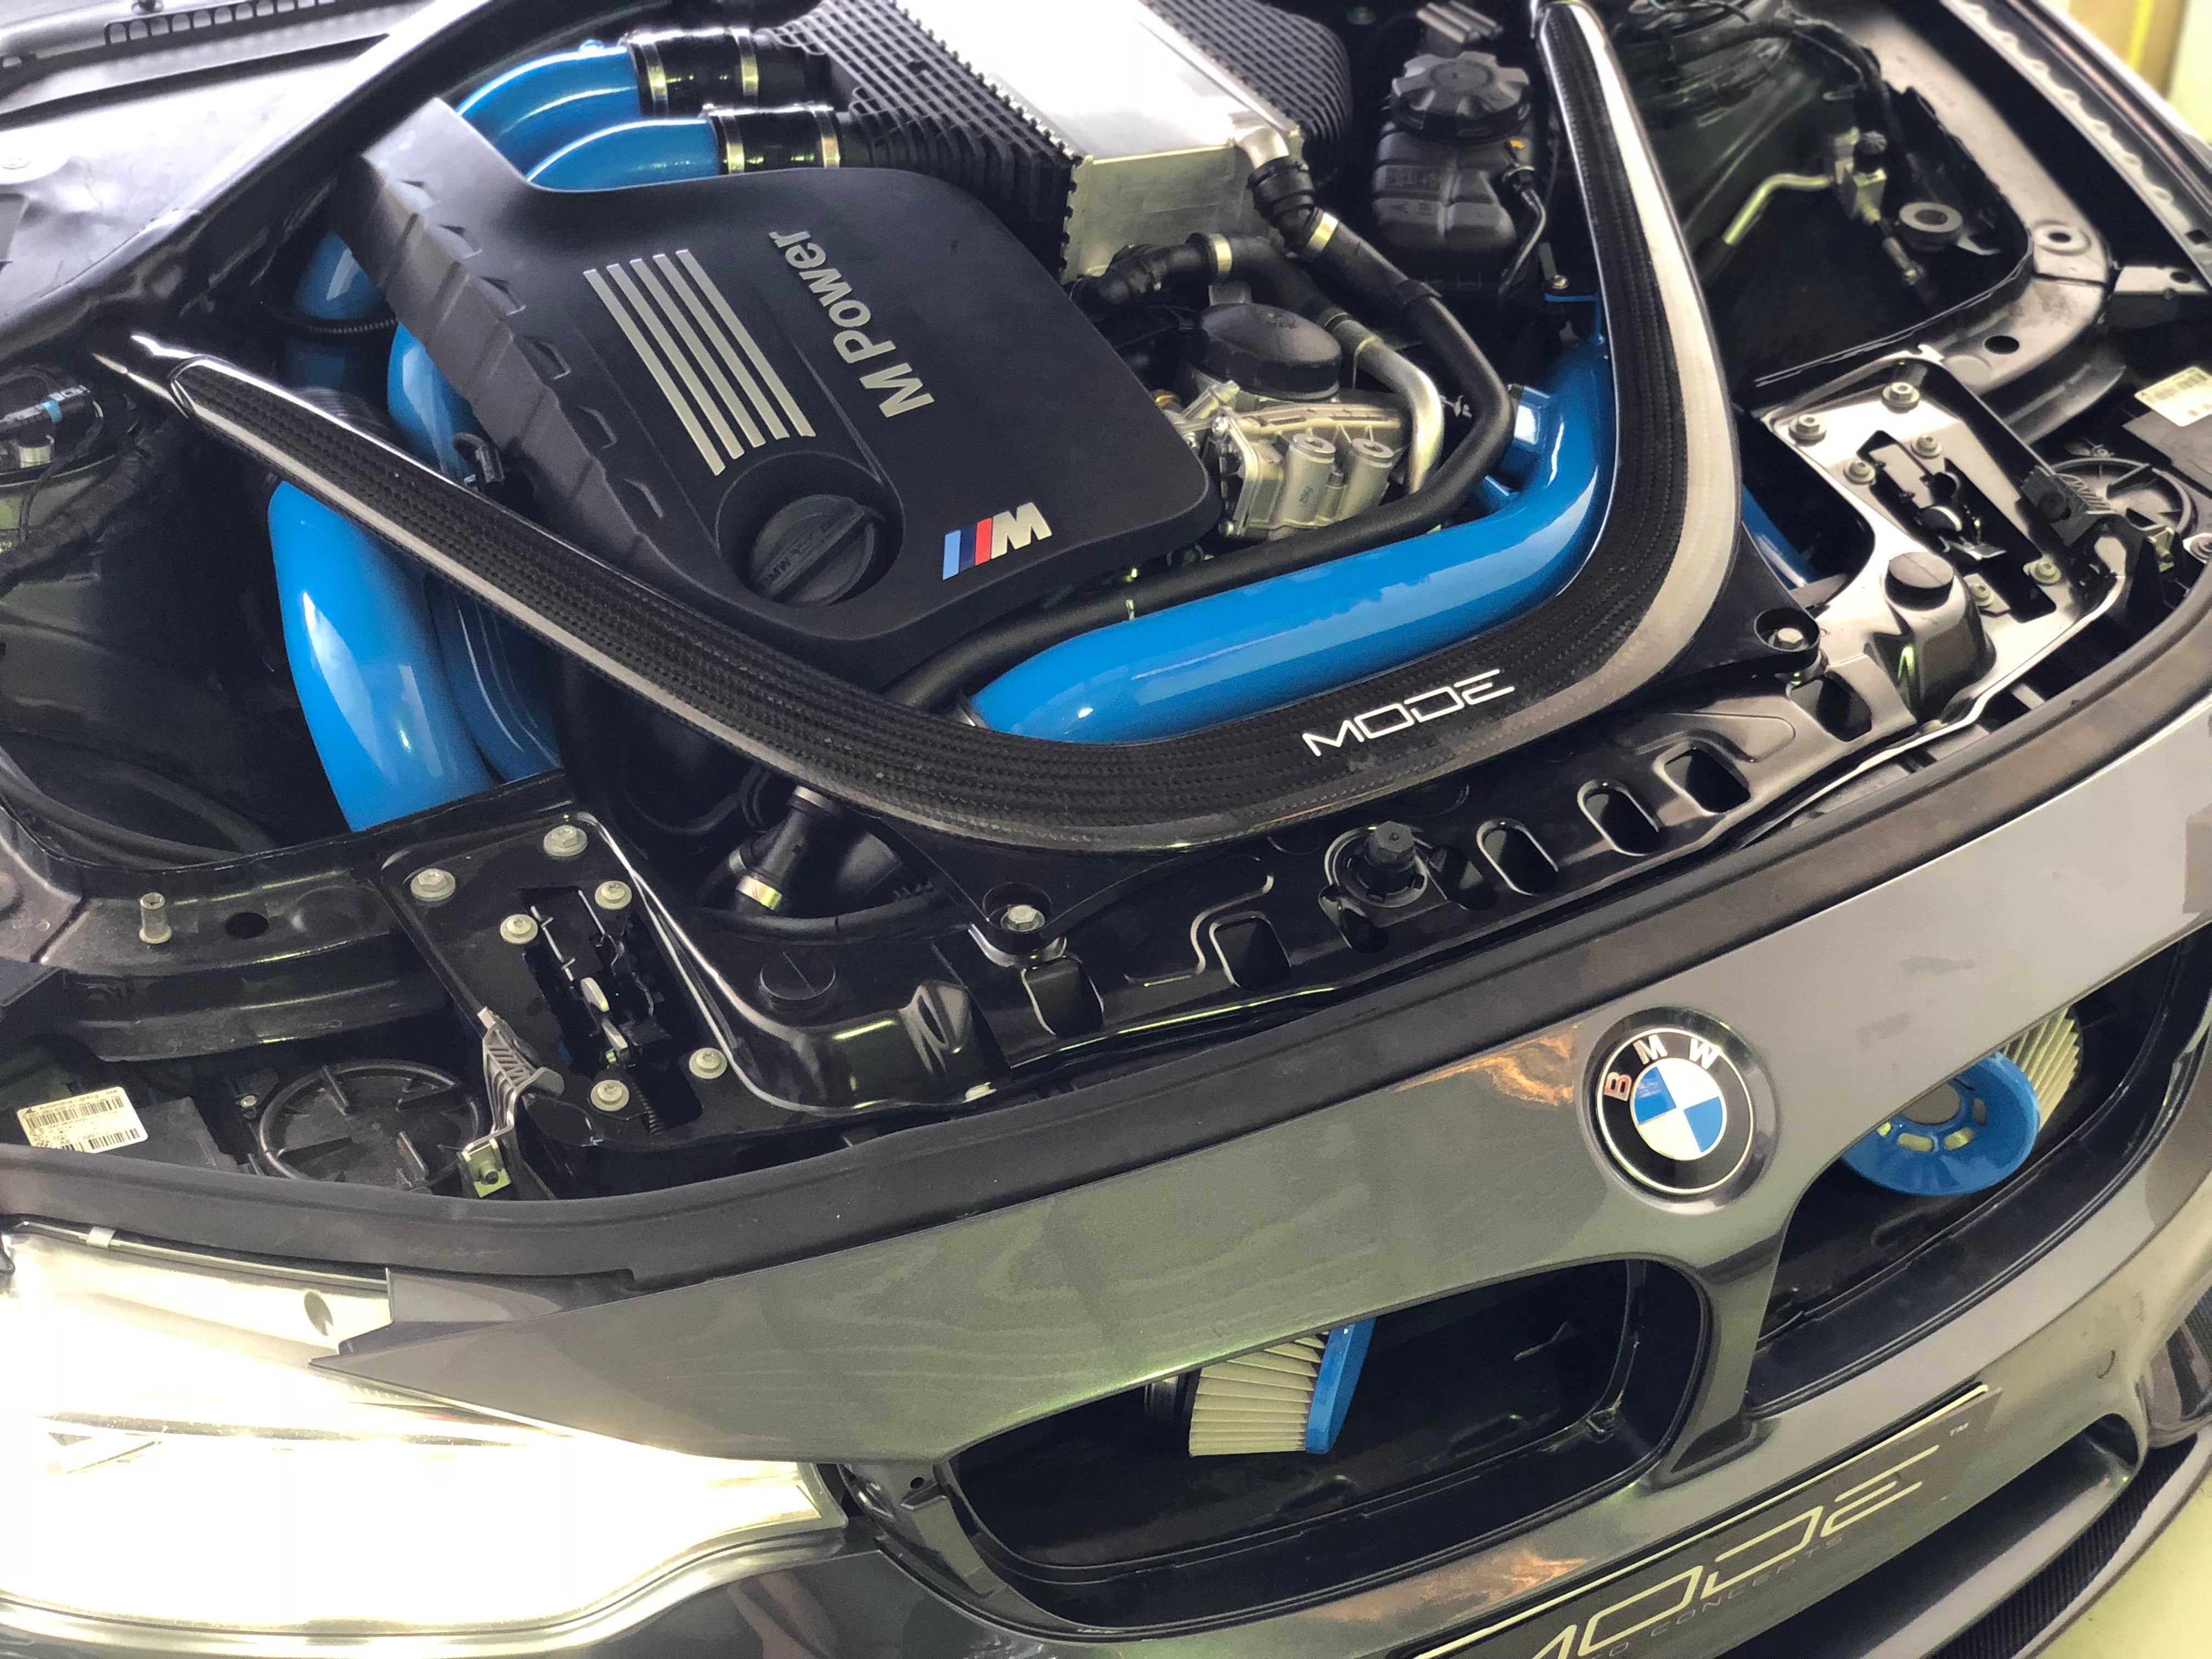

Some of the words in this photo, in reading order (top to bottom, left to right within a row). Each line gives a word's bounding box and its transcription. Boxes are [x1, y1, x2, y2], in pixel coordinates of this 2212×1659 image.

[769, 230, 896, 363] Power
[859, 362, 935, 418] M
[1302, 669, 1515, 757] MODE
[1604, 1034, 1721, 1102] BMW
[1650, 1537, 1843, 1638] CONCEPTS
